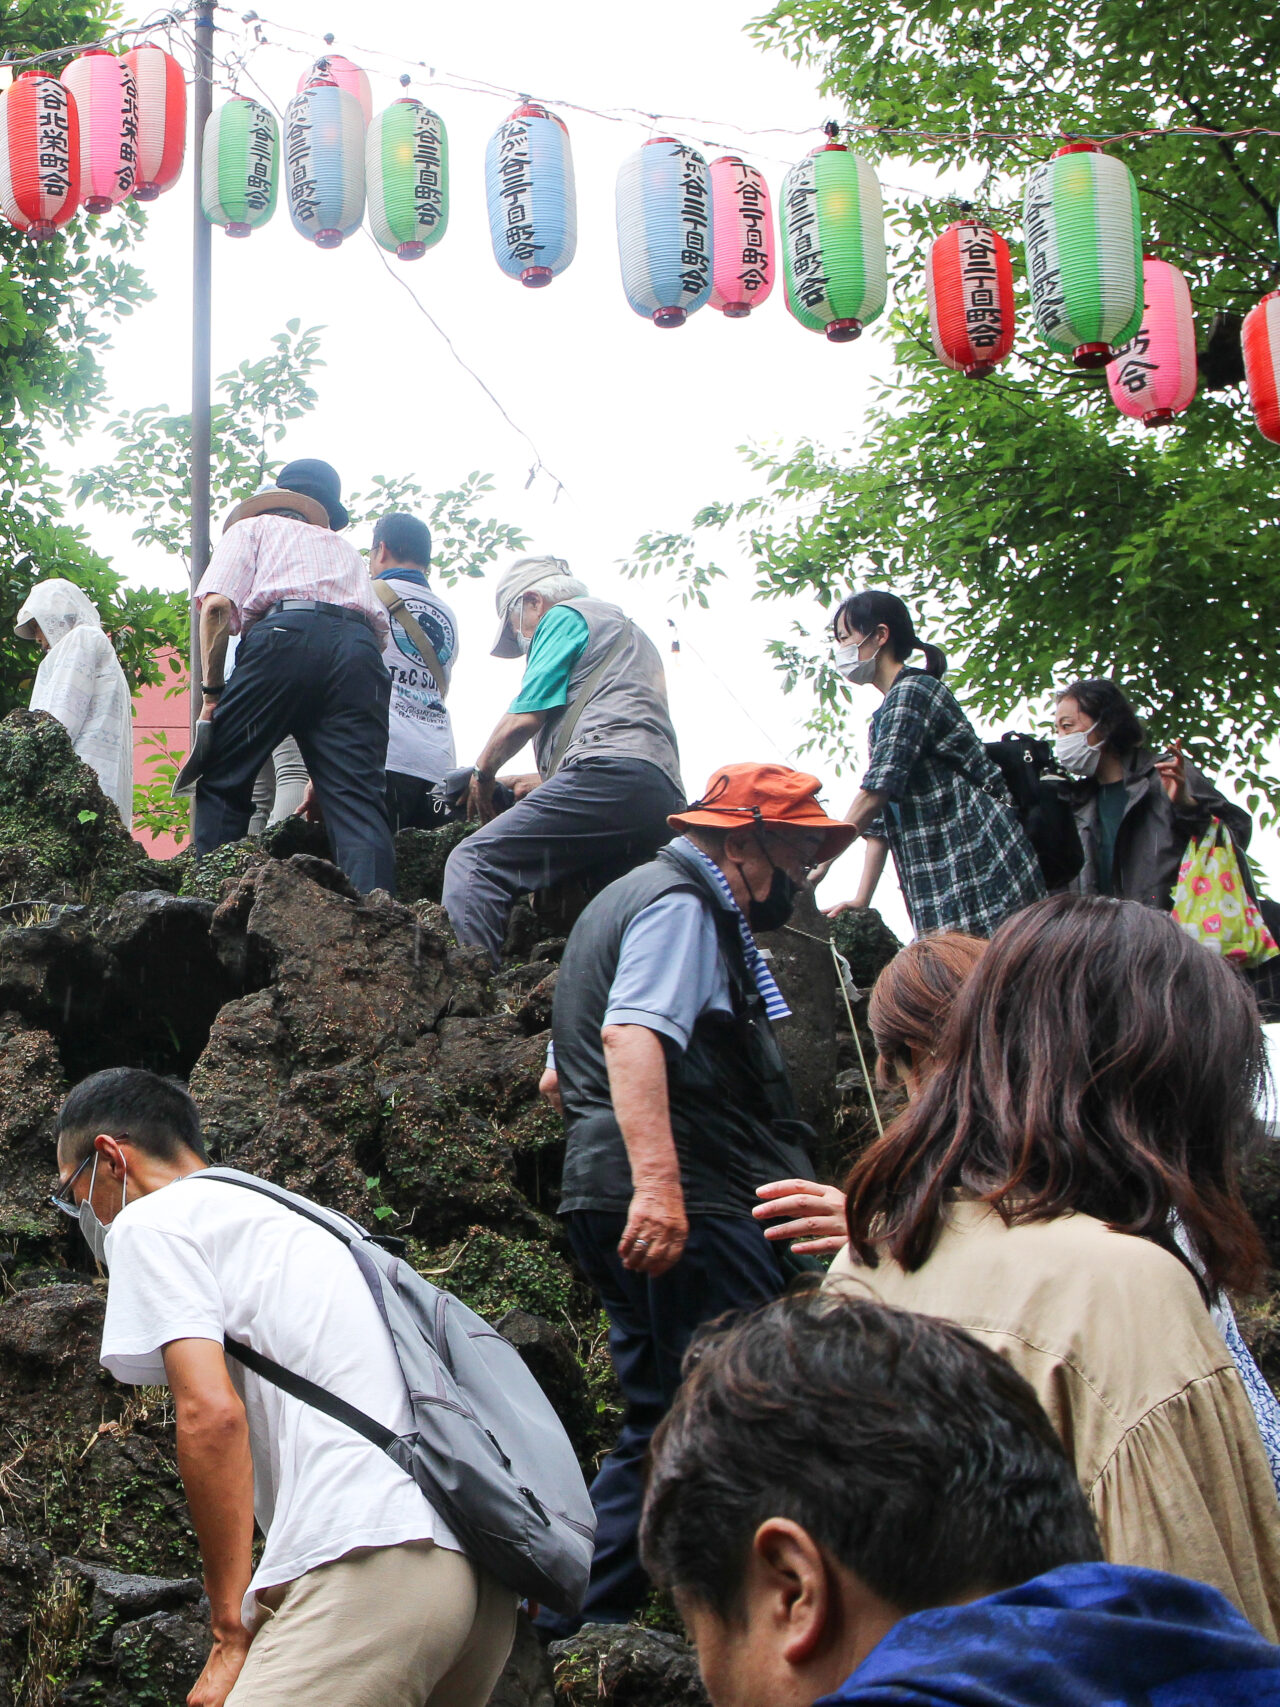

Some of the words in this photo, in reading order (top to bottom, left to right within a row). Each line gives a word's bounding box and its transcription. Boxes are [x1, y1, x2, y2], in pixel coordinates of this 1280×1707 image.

[32, 78, 72, 196] 入谷北栄町会
[406, 103, 443, 226] 松が谷三丁目町会
[495, 119, 546, 260] 松が谷三丁目町会
[669, 143, 710, 294] 松が谷三丁目町会
[730, 162, 769, 291] 下谷二丁目町会
[957, 225, 1004, 347] 下谷二丁目町会
[389, 665, 418, 687] T&C
